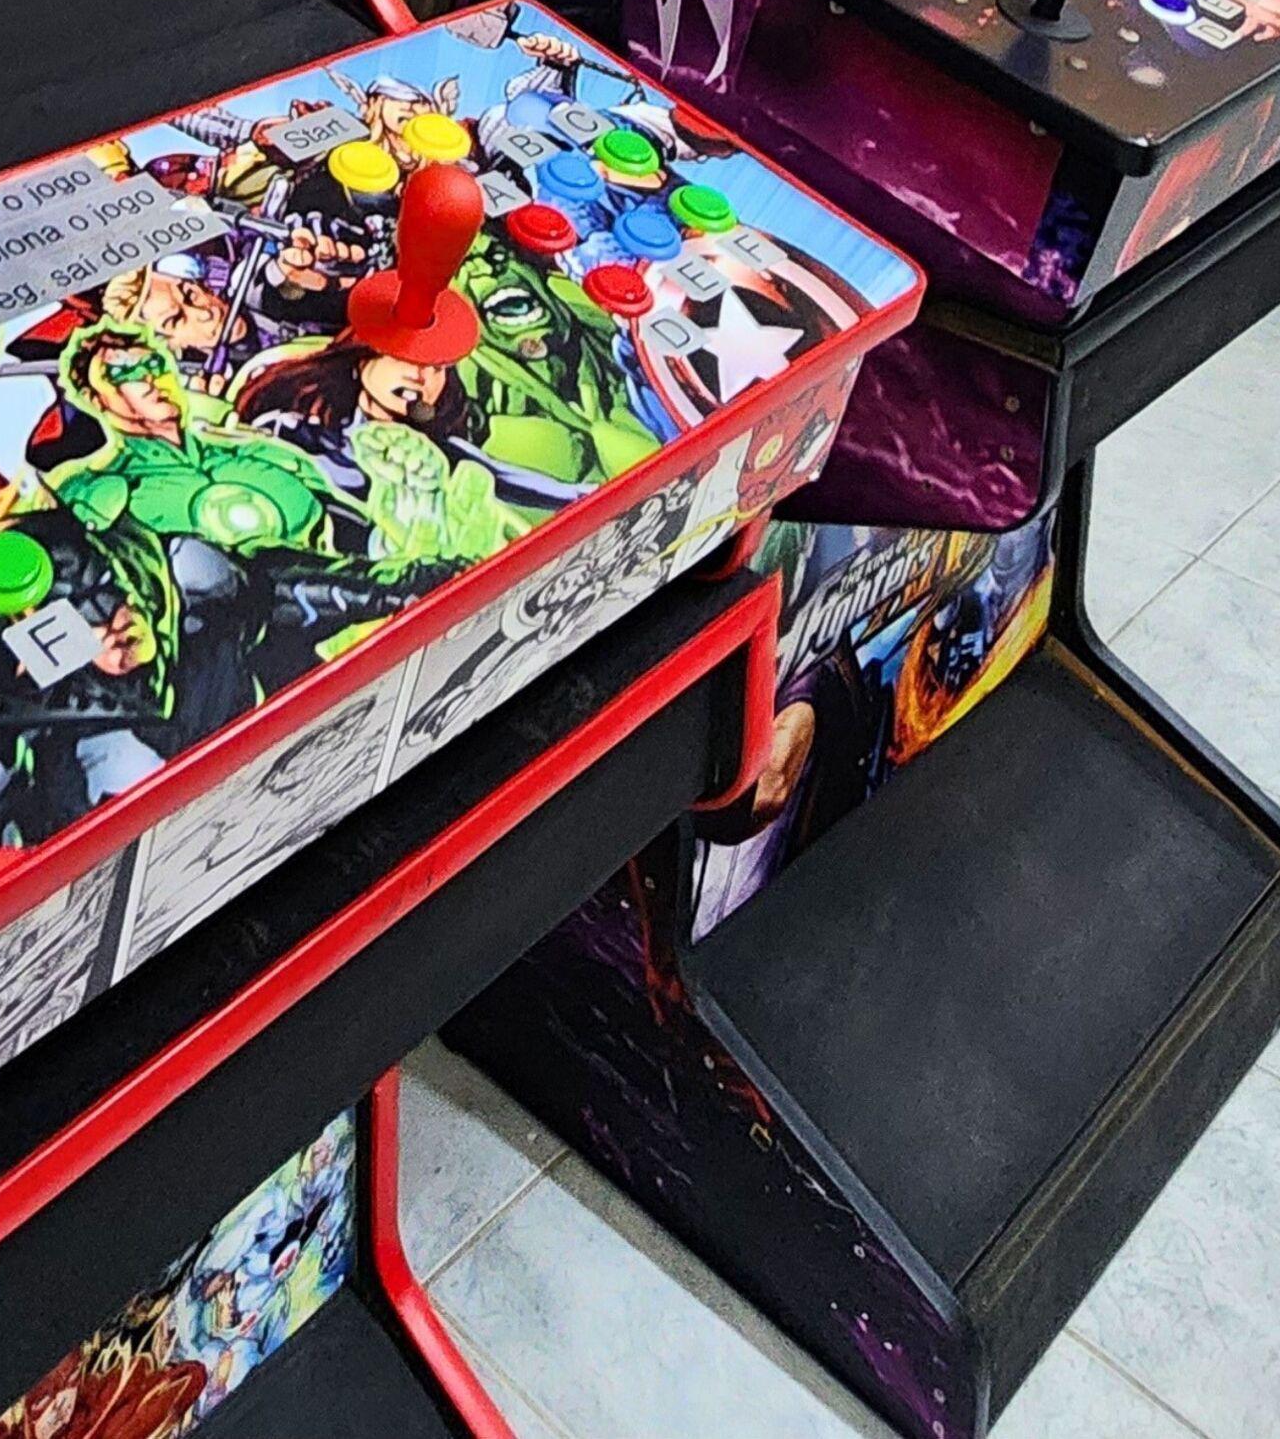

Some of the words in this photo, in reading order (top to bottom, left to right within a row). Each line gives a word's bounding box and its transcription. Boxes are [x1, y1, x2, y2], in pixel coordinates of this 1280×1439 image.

[1198, 24, 1229, 42] D
[282, 116, 351, 155] Start
[565, 110, 599, 133] C
[513, 134, 546, 158] B
[3, 193, 24, 214] o
[26, 167, 93, 209] jogo
[482, 182, 517, 209] A
[68, 213, 90, 233] o
[93, 187, 156, 229] jogo
[51, 255, 98, 289] sai
[101, 236, 141, 268] do
[145, 214, 207, 254] jogo
[737, 233, 768, 264] F
[678, 264, 721, 293] E
[660, 318, 692, 346] D
[29, 617, 78, 666] F
